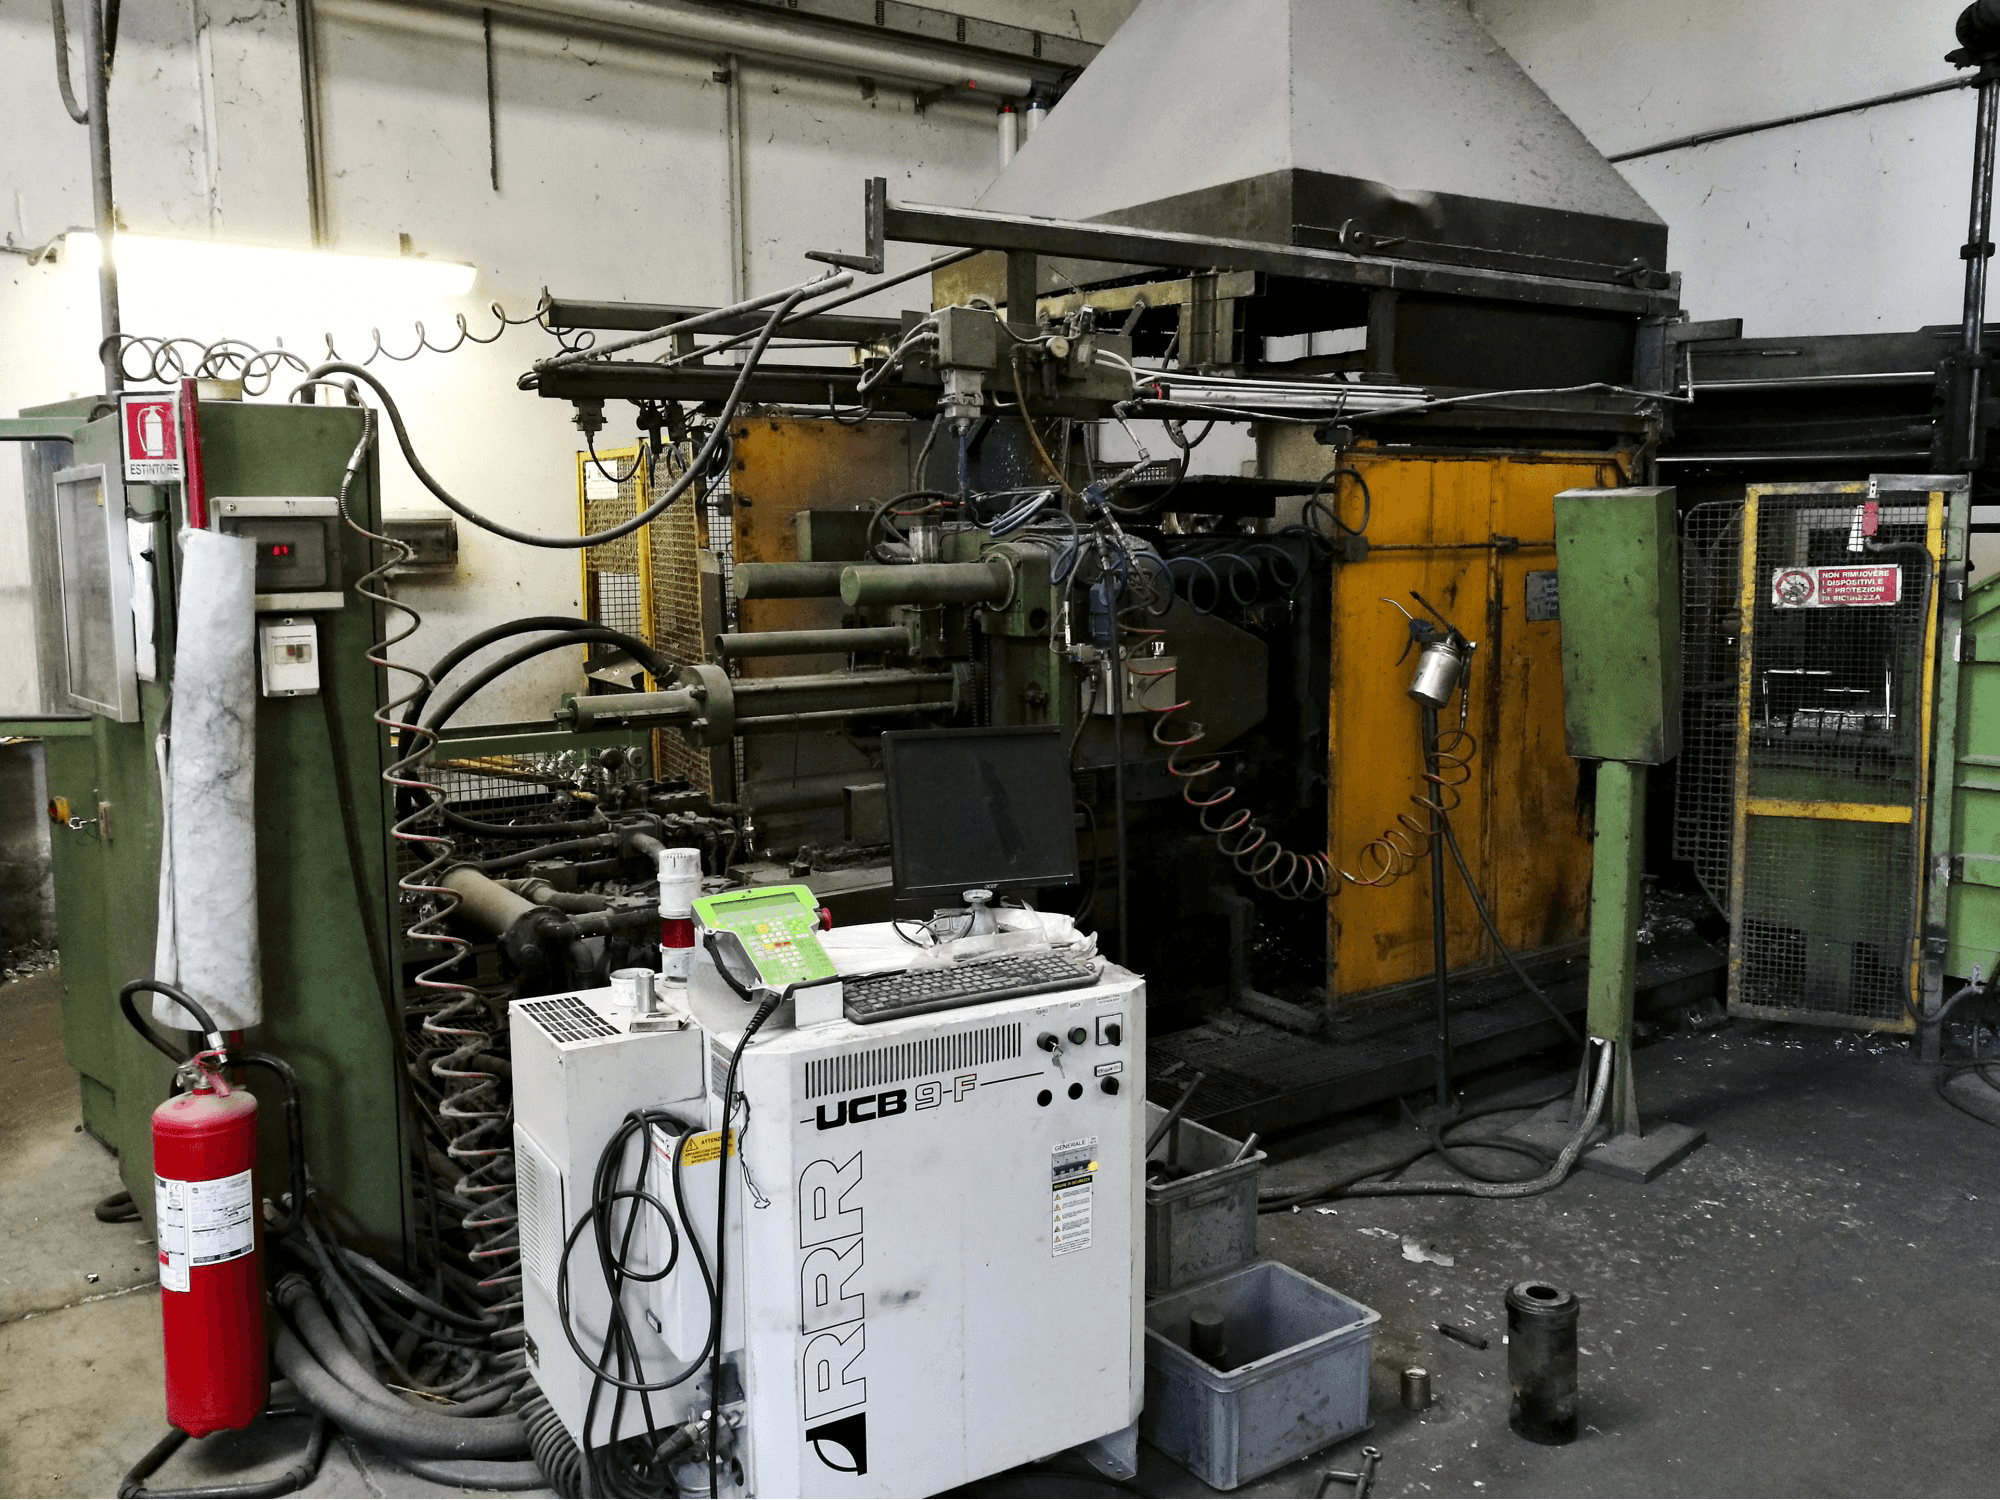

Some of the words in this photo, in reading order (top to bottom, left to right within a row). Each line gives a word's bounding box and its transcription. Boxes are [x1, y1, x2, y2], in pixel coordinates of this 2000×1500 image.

[130, 463, 180, 475] ESTINTORE
[816, 1088, 907, 1131] UCB
[914, 1073, 977, 1111] 9-F
[1054, 1140, 1086, 1152] GENERALE
